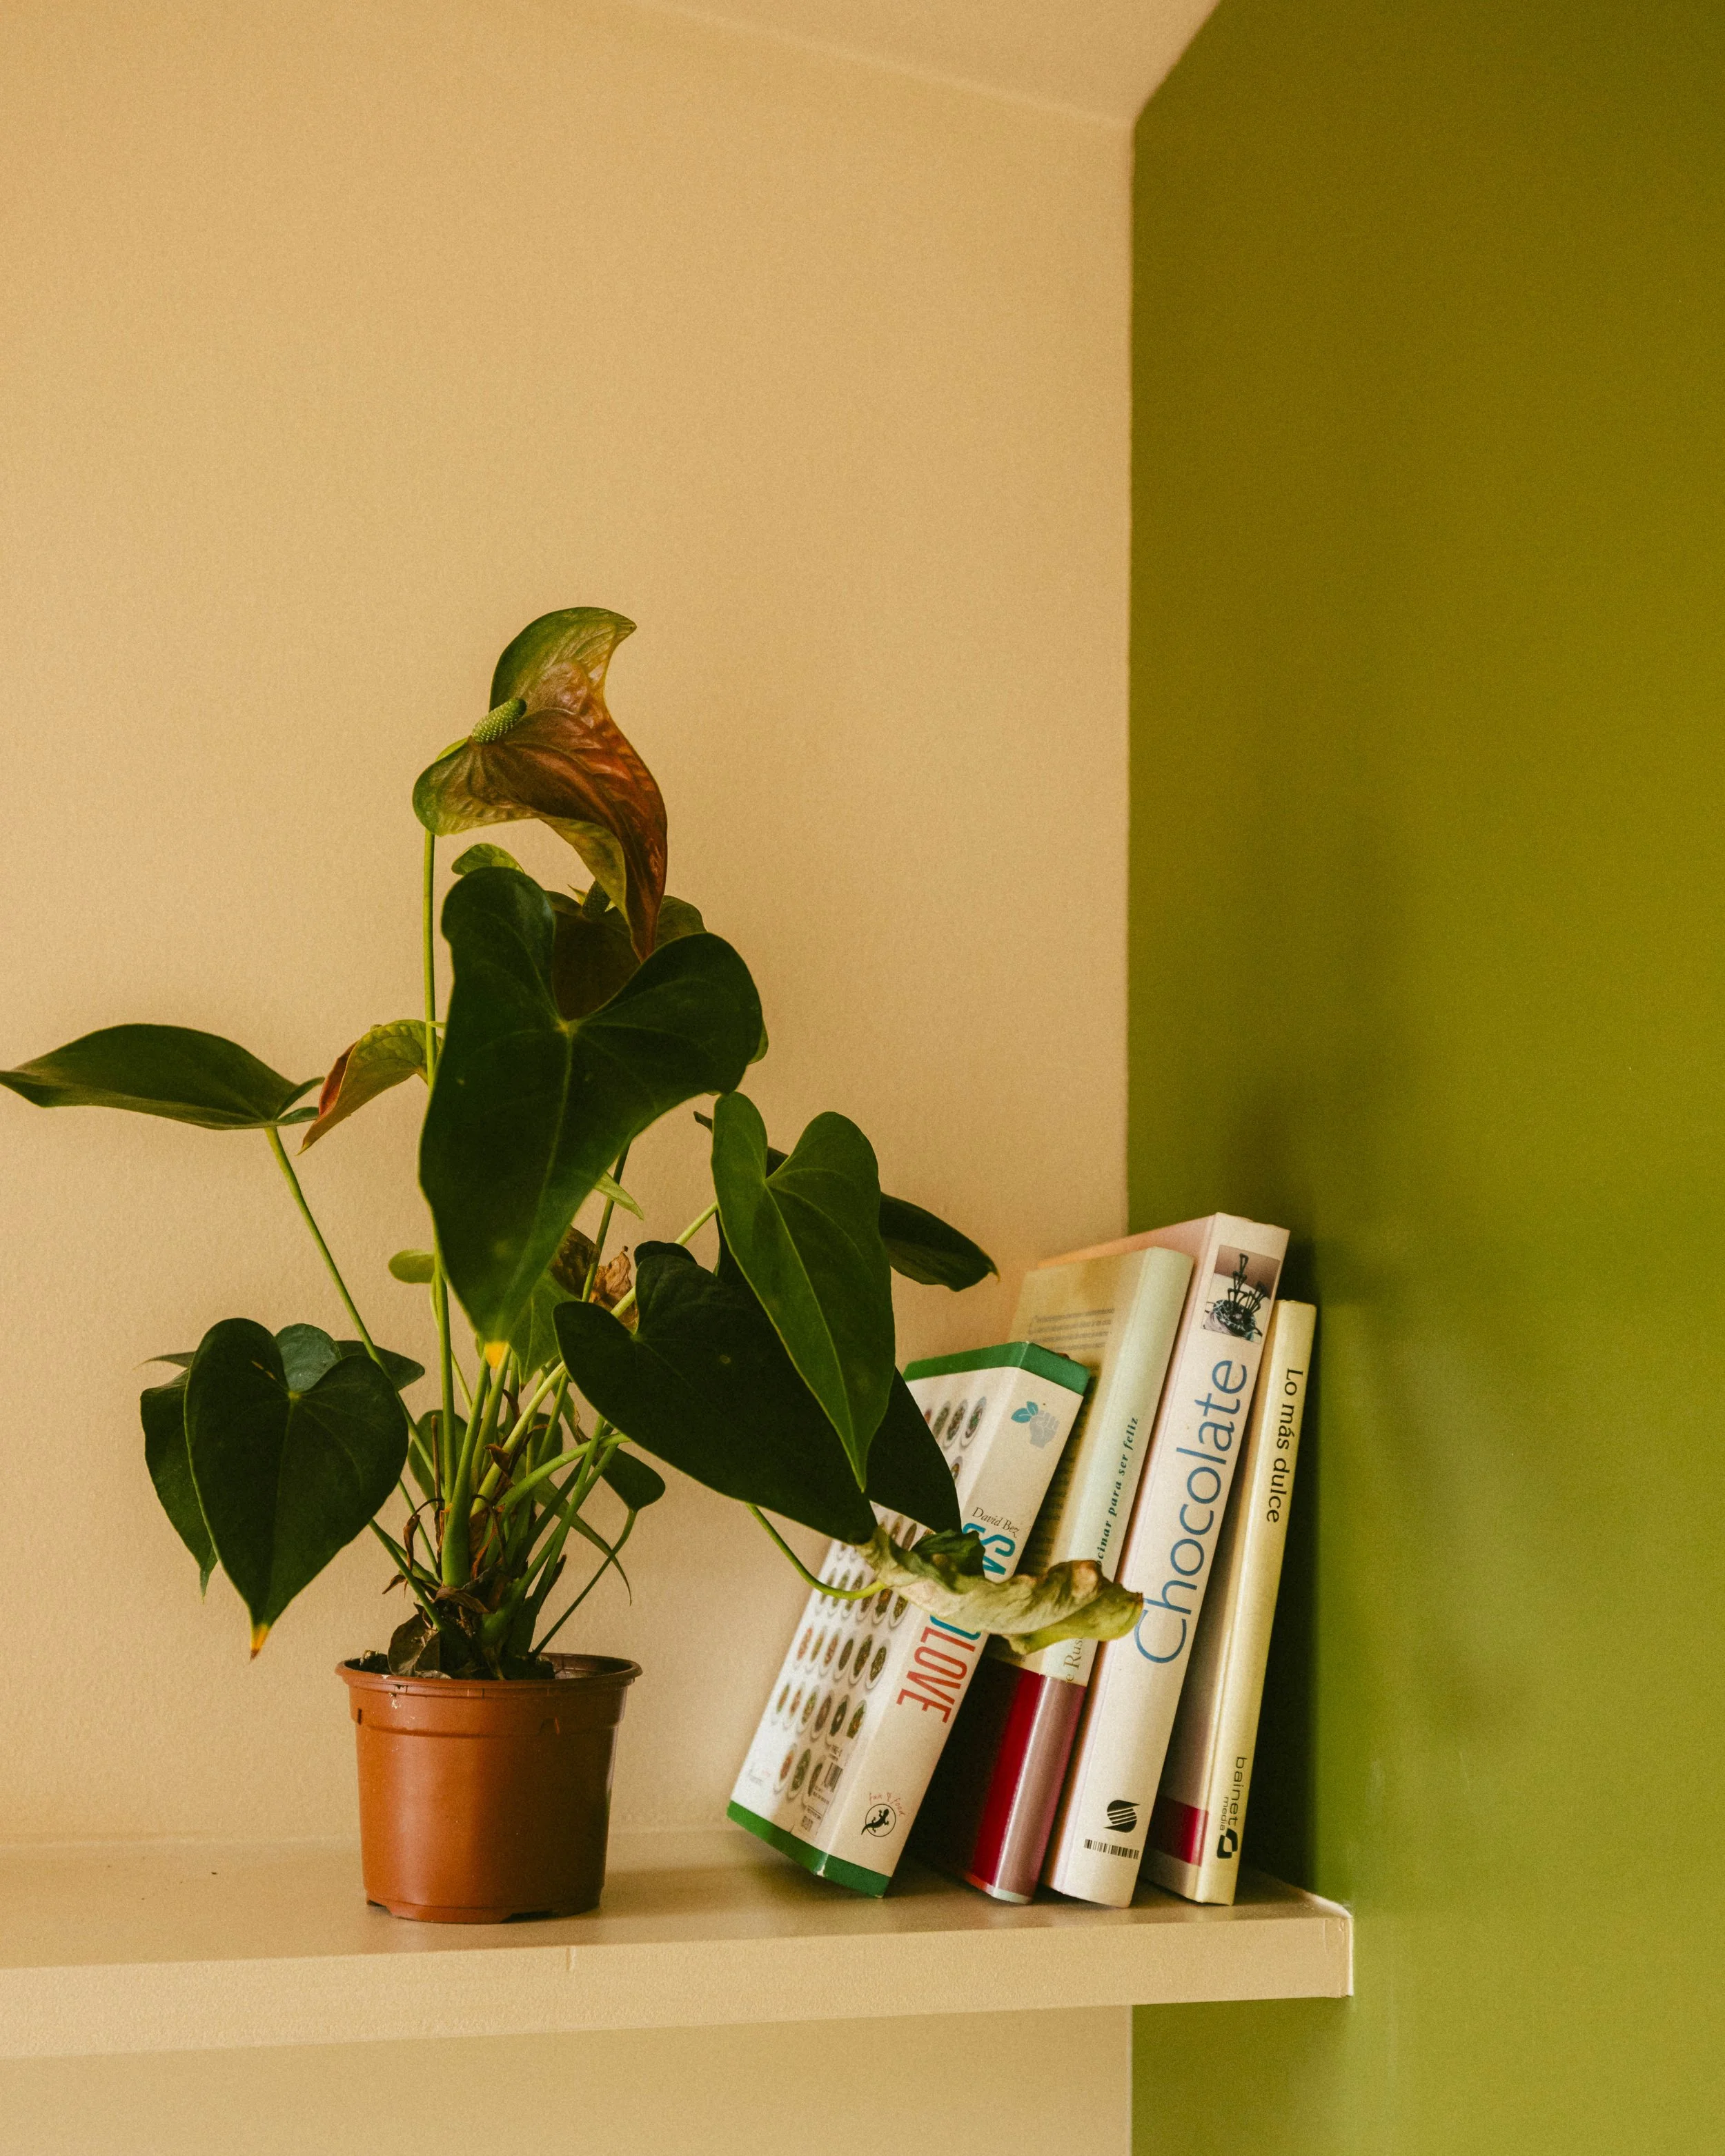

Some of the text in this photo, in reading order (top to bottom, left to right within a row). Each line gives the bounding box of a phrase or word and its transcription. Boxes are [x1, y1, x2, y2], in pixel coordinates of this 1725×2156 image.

[1096, 1416, 1138, 1567] ocinar para ser feliz
[1266, 1367, 1304, 1523] Lo más dulce
[972, 1506, 1020, 1539] David Bez
[1134, 1359, 1248, 1664] Chocolate
[896, 1626, 976, 1723] LOVE
[1220, 1795, 1229, 1832] media
[1228, 1756, 1248, 1827] bainet
